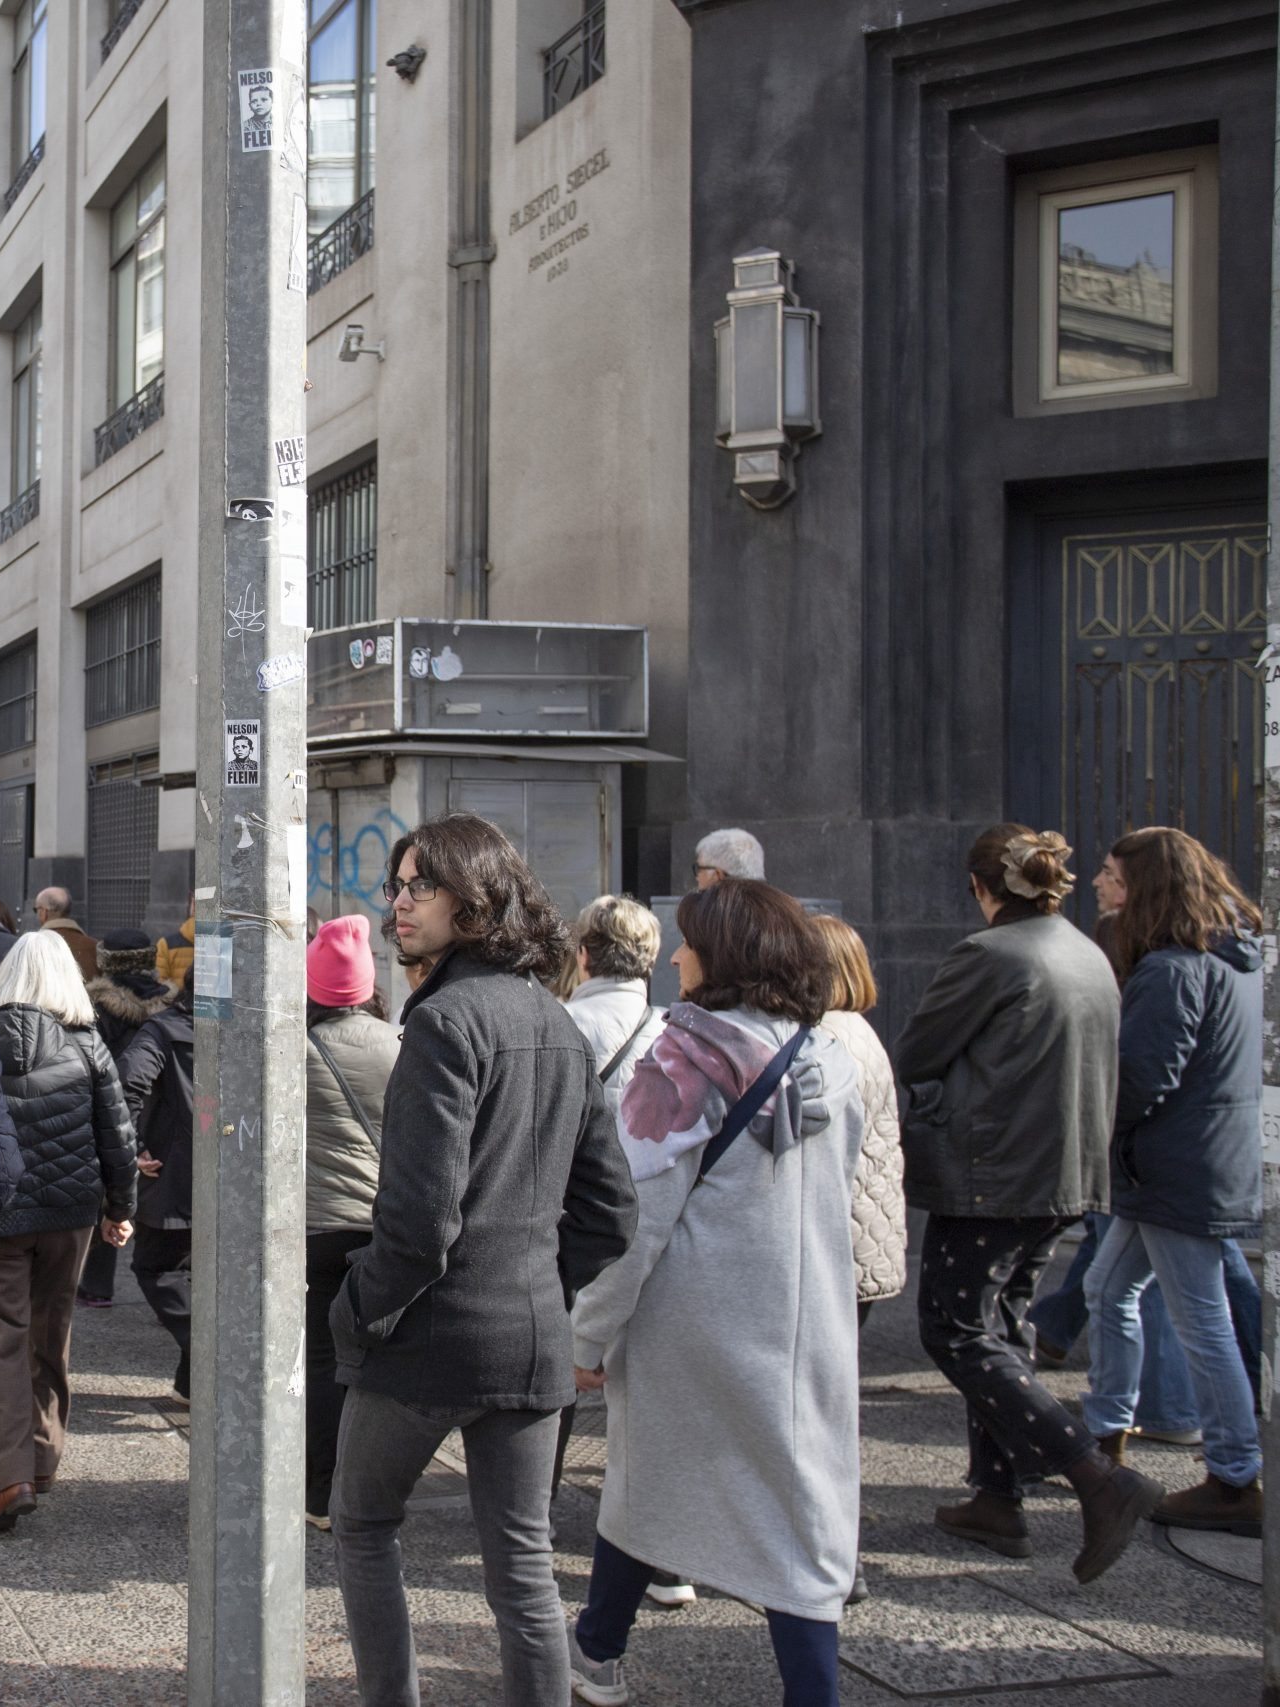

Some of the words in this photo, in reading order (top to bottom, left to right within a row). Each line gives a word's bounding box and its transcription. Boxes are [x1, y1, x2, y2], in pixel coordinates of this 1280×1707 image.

[509, 184, 559, 236] ALBERTO
[227, 724, 258, 735] NELSON
[227, 770, 258, 785] FLEIM
